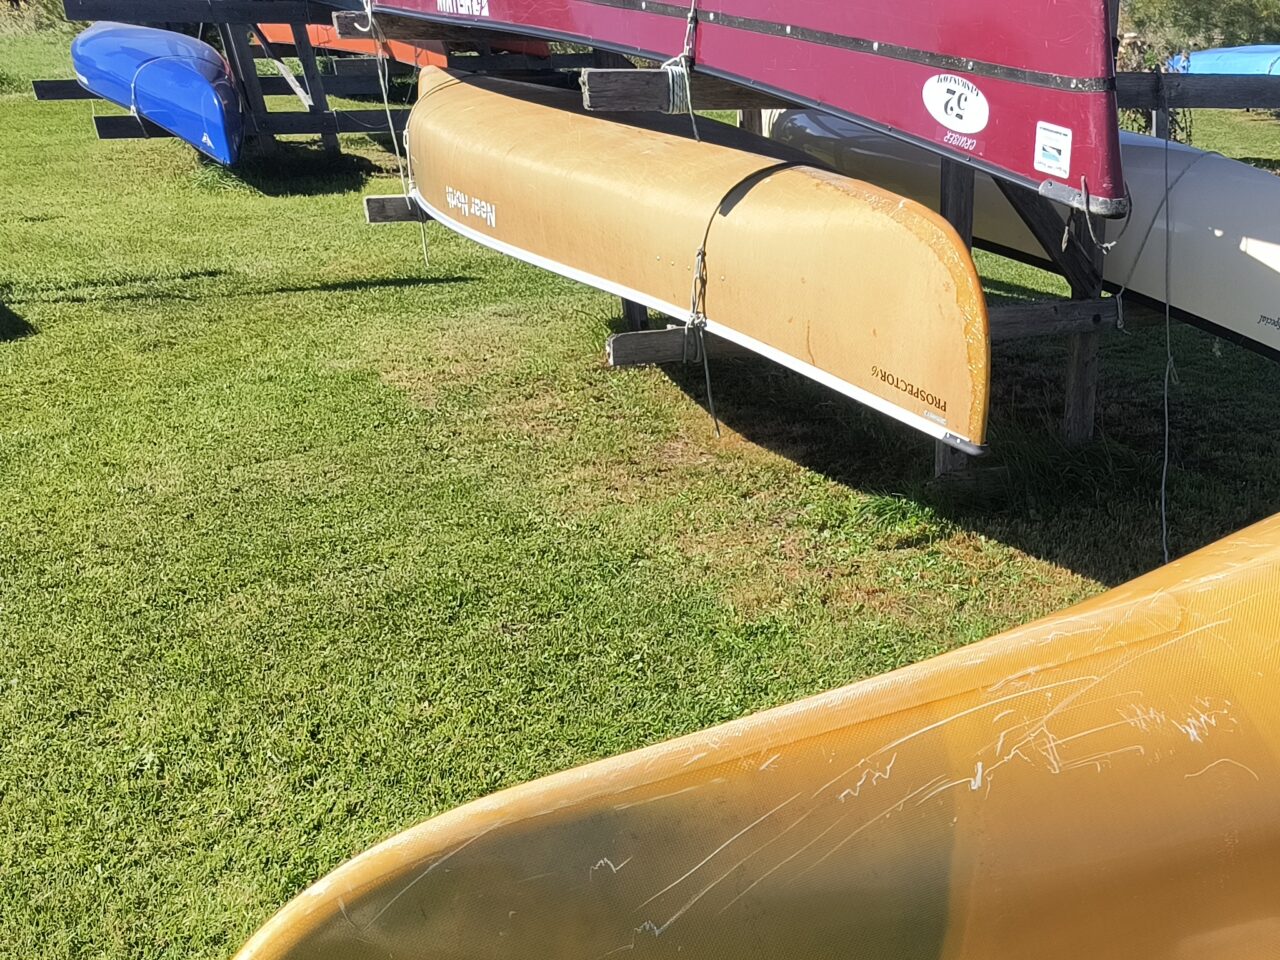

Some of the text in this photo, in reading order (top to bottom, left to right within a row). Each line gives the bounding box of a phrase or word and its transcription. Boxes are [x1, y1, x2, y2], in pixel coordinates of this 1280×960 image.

[943, 88, 968, 120] 52
[943, 131, 977, 151] CRUISER
[470, 197, 496, 228] Near
[879, 369, 947, 412] PROSPECTOR
